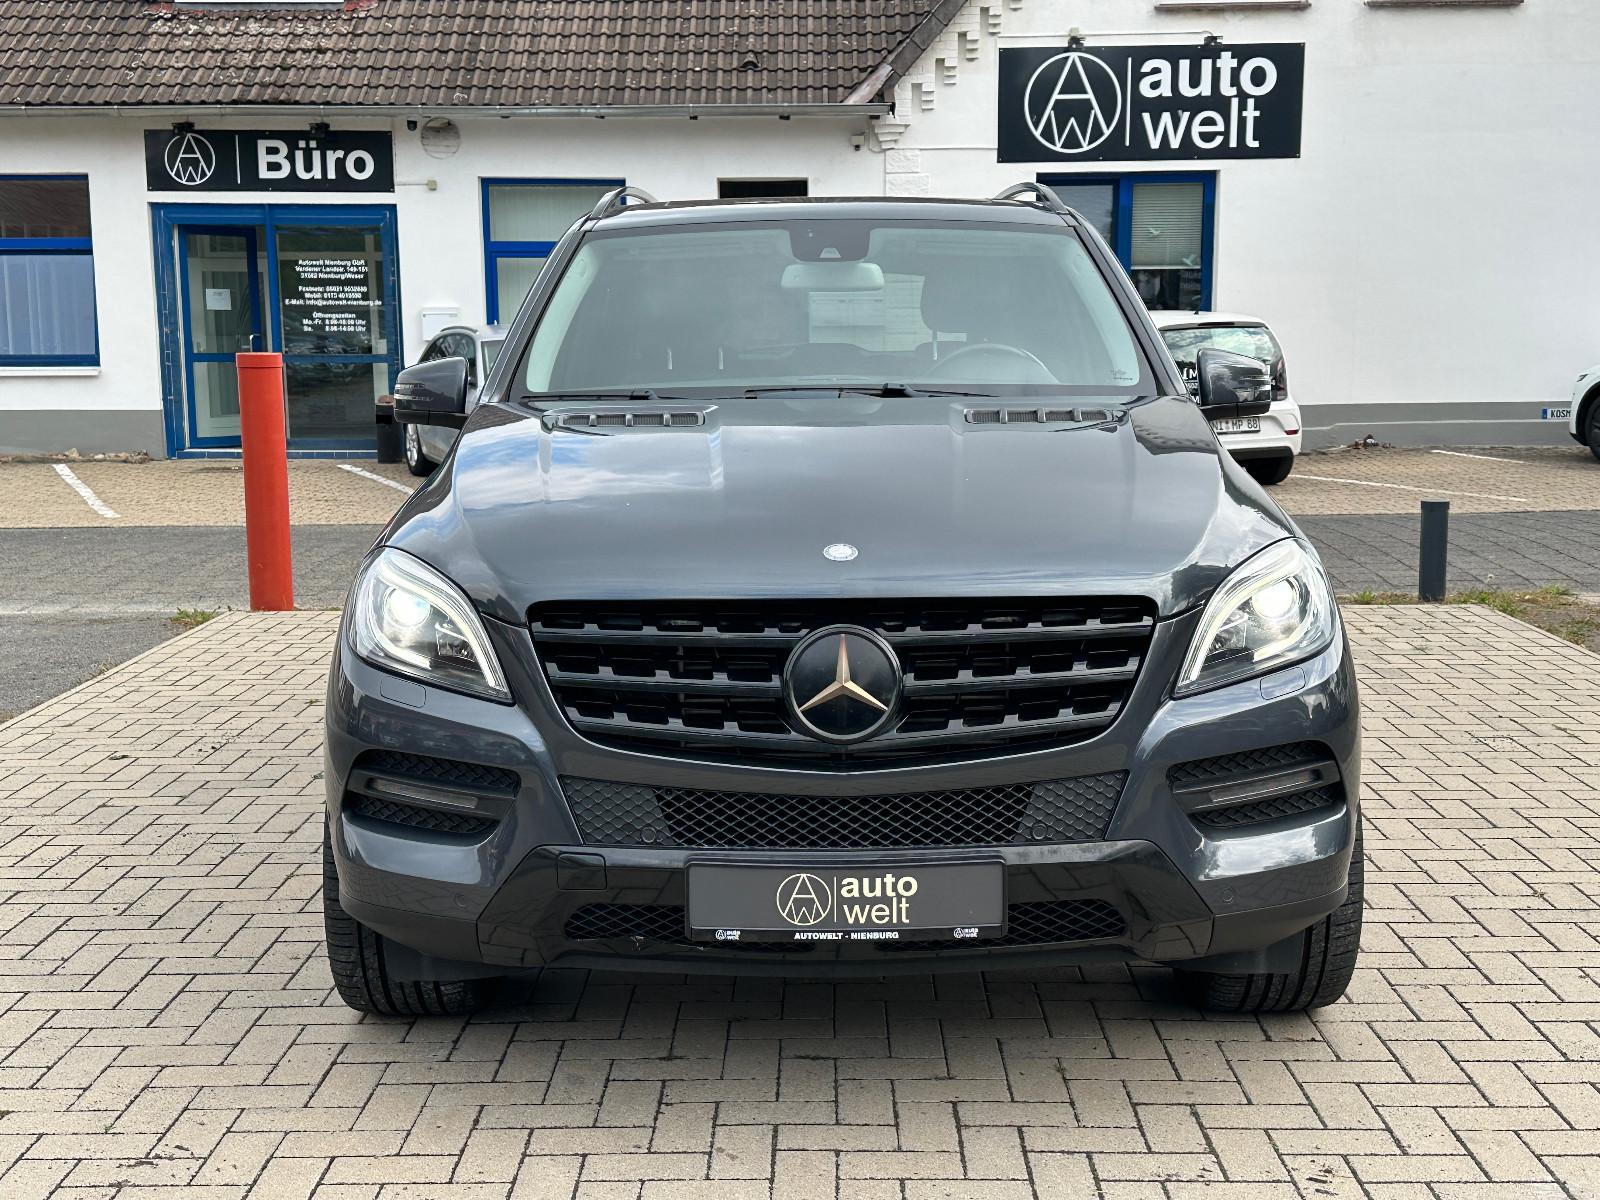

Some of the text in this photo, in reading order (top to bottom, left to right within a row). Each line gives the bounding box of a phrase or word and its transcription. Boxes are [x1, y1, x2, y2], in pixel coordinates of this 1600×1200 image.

[1138, 51, 1278, 98] auto
[1142, 97, 1261, 150] welt
[257, 139, 375, 181] Büro
[840, 873, 919, 898] auto
[843, 897, 911, 924] welt
[793, 932, 843, 940] AUTOWELT
[850, 931, 900, 940] NIENBURG
